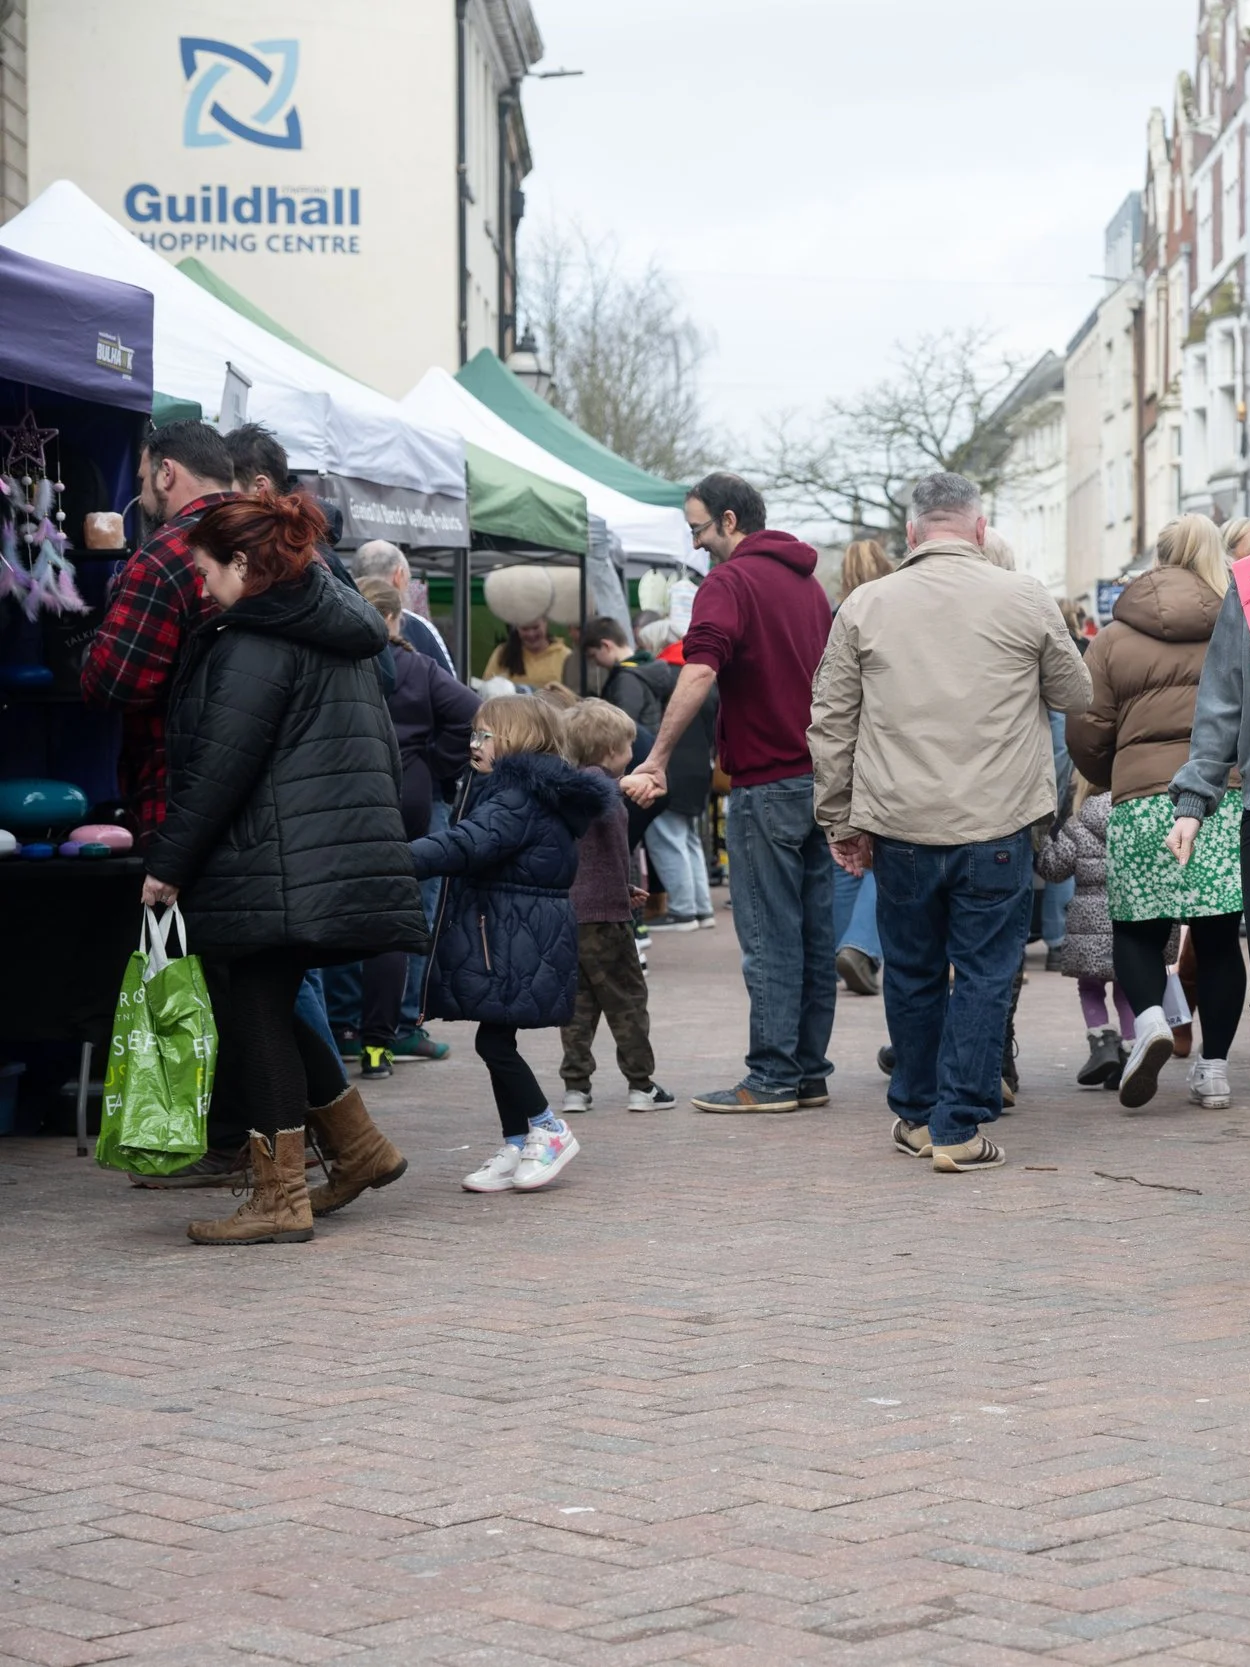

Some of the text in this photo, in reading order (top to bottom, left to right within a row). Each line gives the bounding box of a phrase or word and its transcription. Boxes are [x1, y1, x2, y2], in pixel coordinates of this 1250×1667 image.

[124, 183, 360, 225] Guildhall
[131, 231, 361, 254] HOPPING CENTRE
